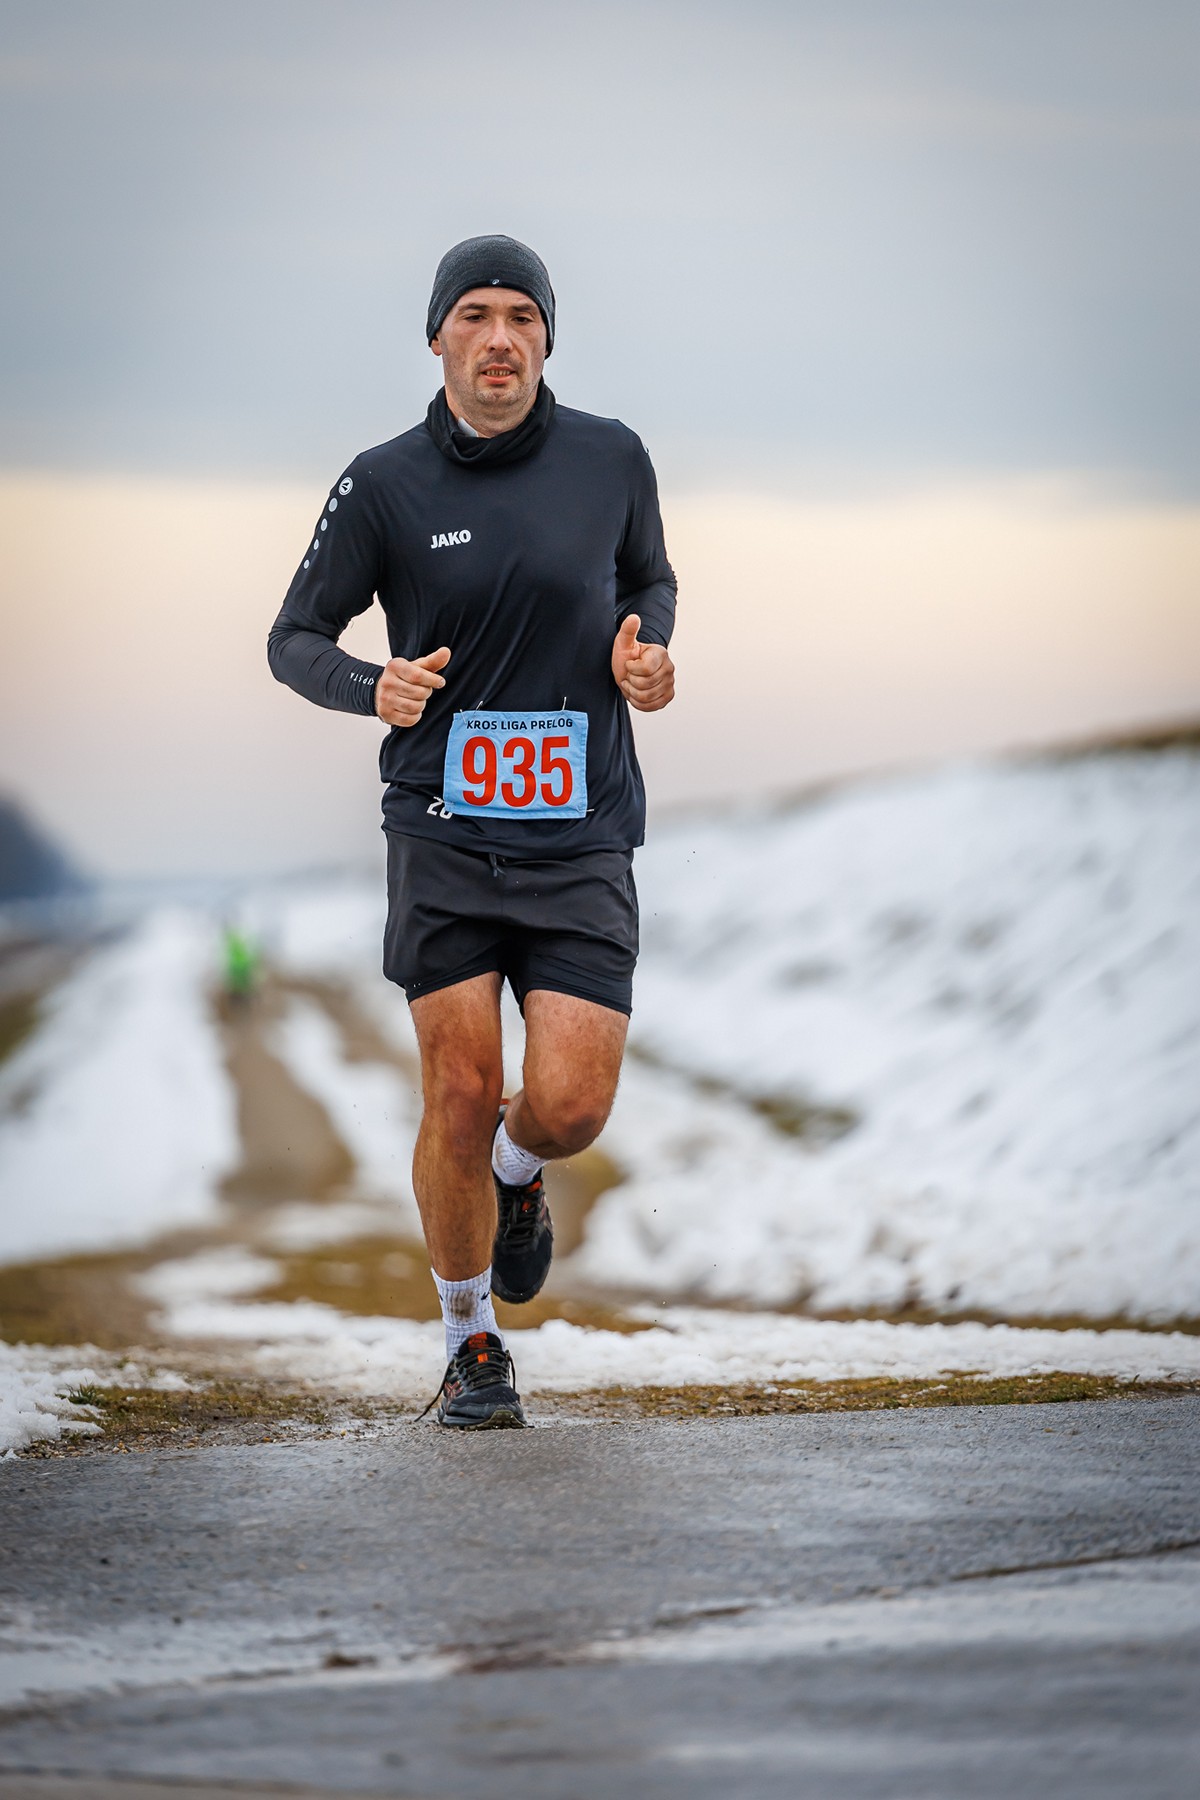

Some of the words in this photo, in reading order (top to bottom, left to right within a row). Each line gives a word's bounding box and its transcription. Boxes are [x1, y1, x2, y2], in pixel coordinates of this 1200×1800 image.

[430, 529, 472, 549] JAKO
[466, 720, 497, 730] KROS
[500, 720, 528, 730] LIGA
[530, 718, 573, 730] PRELOG
[461, 735, 573, 808] 935
